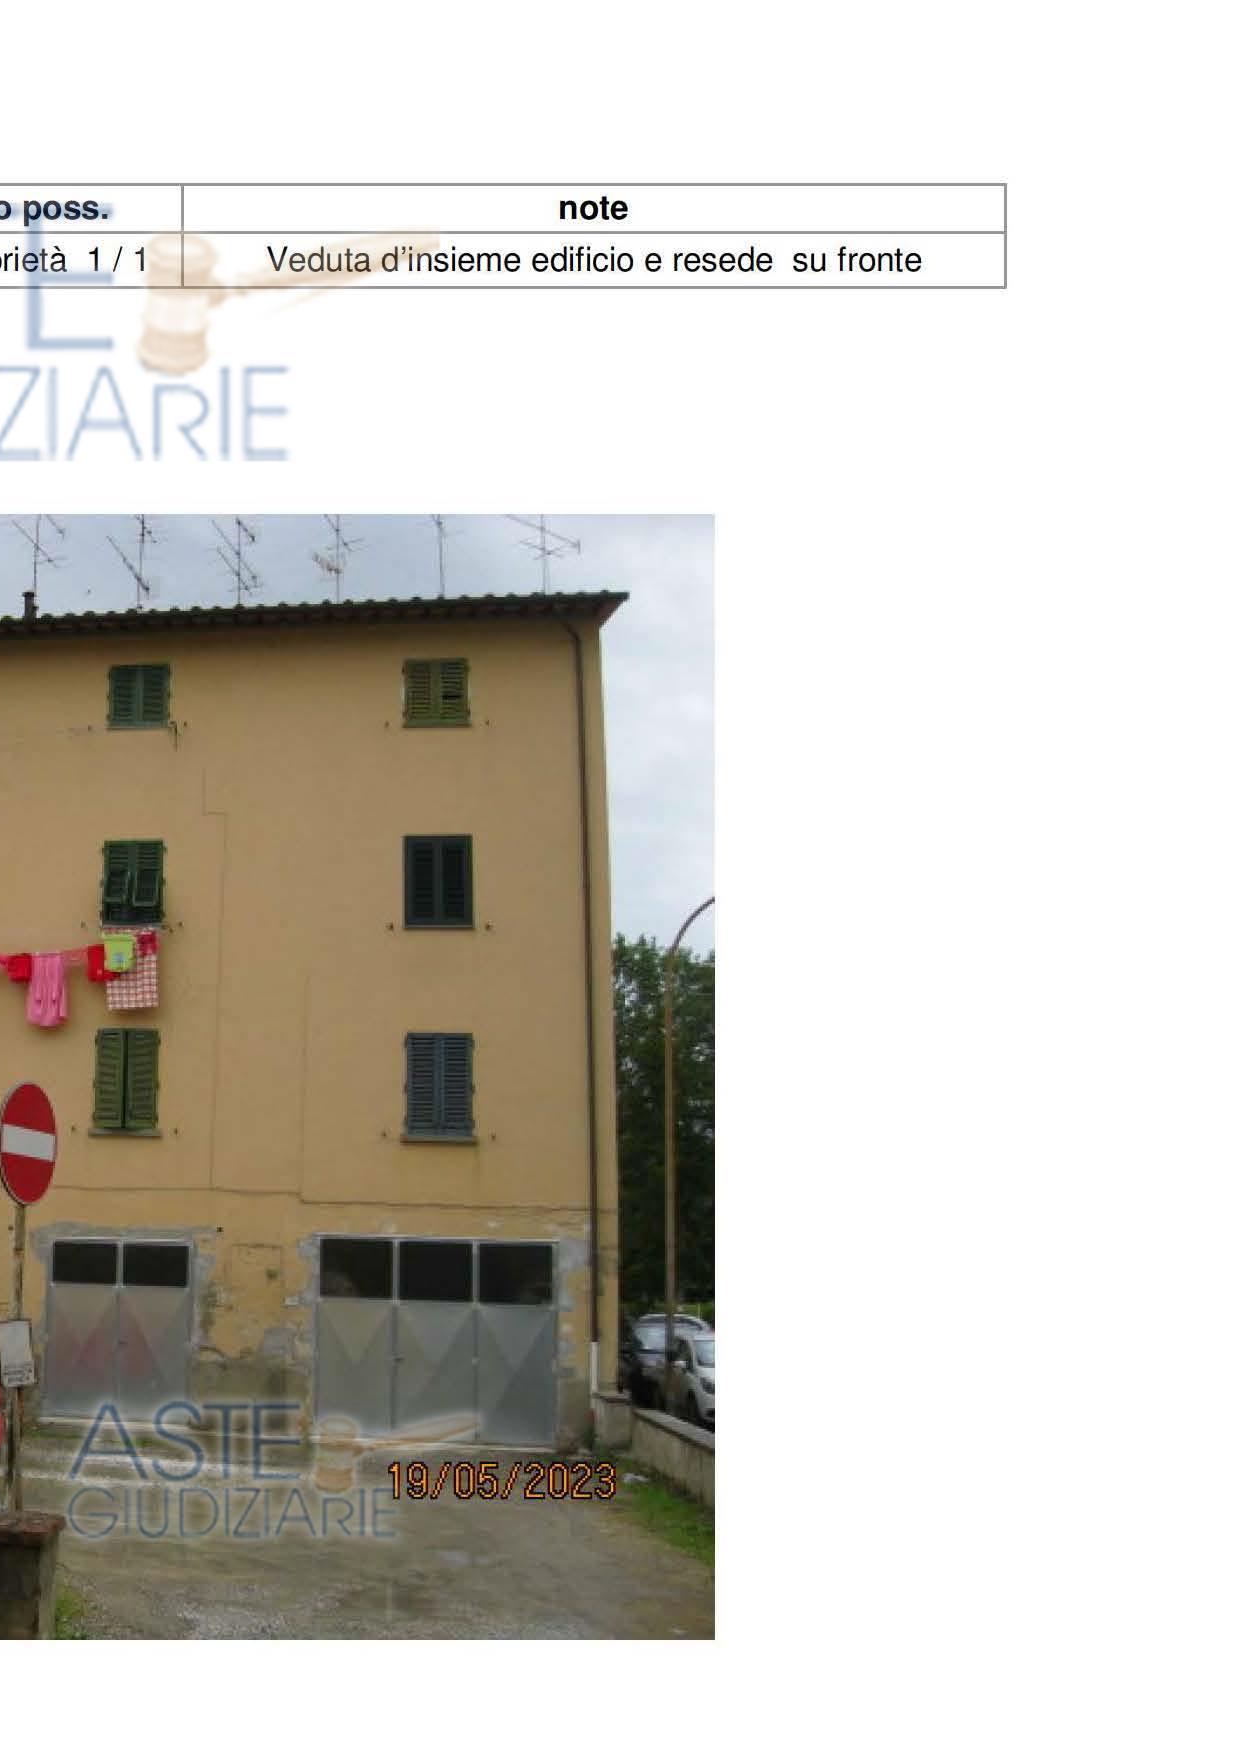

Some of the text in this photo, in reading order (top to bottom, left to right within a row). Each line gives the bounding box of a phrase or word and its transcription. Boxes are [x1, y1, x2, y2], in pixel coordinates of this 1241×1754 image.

[23, 200, 108, 227] poss.
[559, 196, 629, 221] note
[88, 246, 99, 272] 1
[112, 246, 123, 272] /
[135, 246, 146, 272] 1
[266, 246, 372, 273] Veduta
[531, 246, 634, 273] edificio
[644, 252, 662, 273] e
[673, 246, 773, 273] resede
[792, 252, 826, 273] su
[837, 246, 922, 273] fronte
